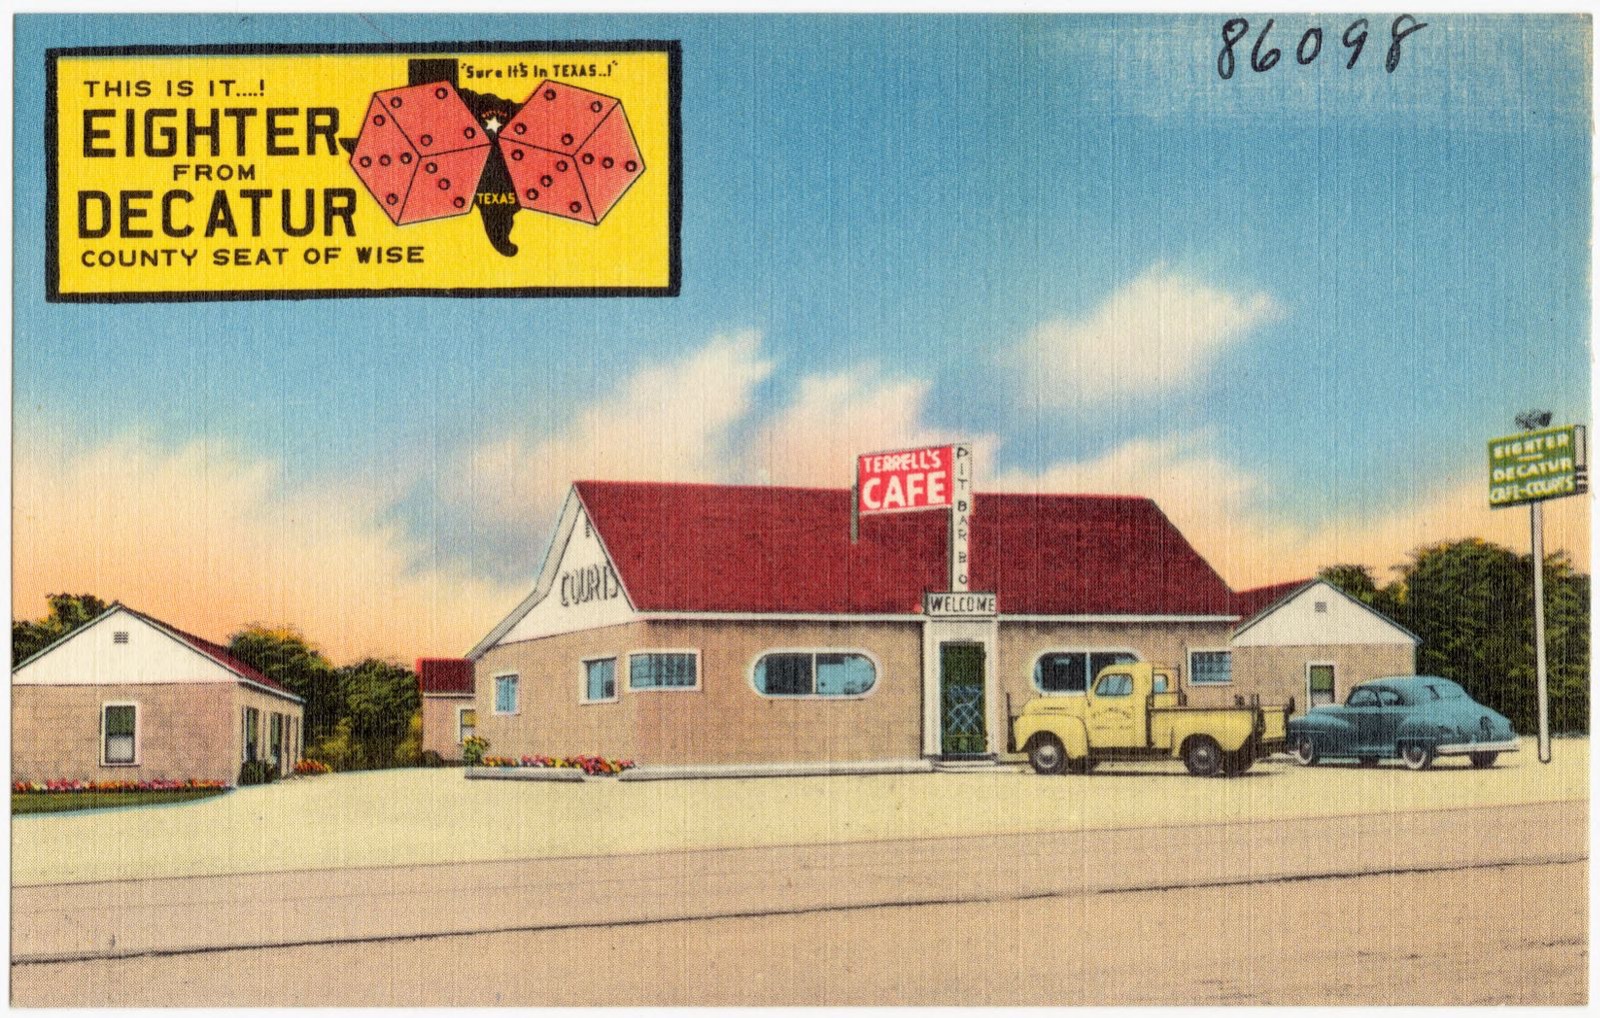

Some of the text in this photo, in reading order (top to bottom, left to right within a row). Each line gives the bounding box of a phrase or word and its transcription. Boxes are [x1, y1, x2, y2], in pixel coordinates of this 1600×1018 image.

[1217, 13, 1429, 80] 86098
[533, 64, 548, 77] In
[83, 80, 152, 98] THIS
[166, 80, 194, 97] IS
[82, 107, 340, 158] EIGHTER
[173, 164, 256, 181] FROM
[476, 192, 516, 205] TEXAS
[77, 188, 357, 239] DECATUR
[81, 247, 425, 267] COUNTY SEAT OF WISE
[1493, 433, 1569, 459] EIGHTER
[864, 449, 942, 473] TERRELL'S
[1493, 457, 1572, 483] DECATUR
[862, 471, 946, 510] CAFE
[561, 563, 619, 607] COURTS
[930, 596, 994, 612] WELCOME
